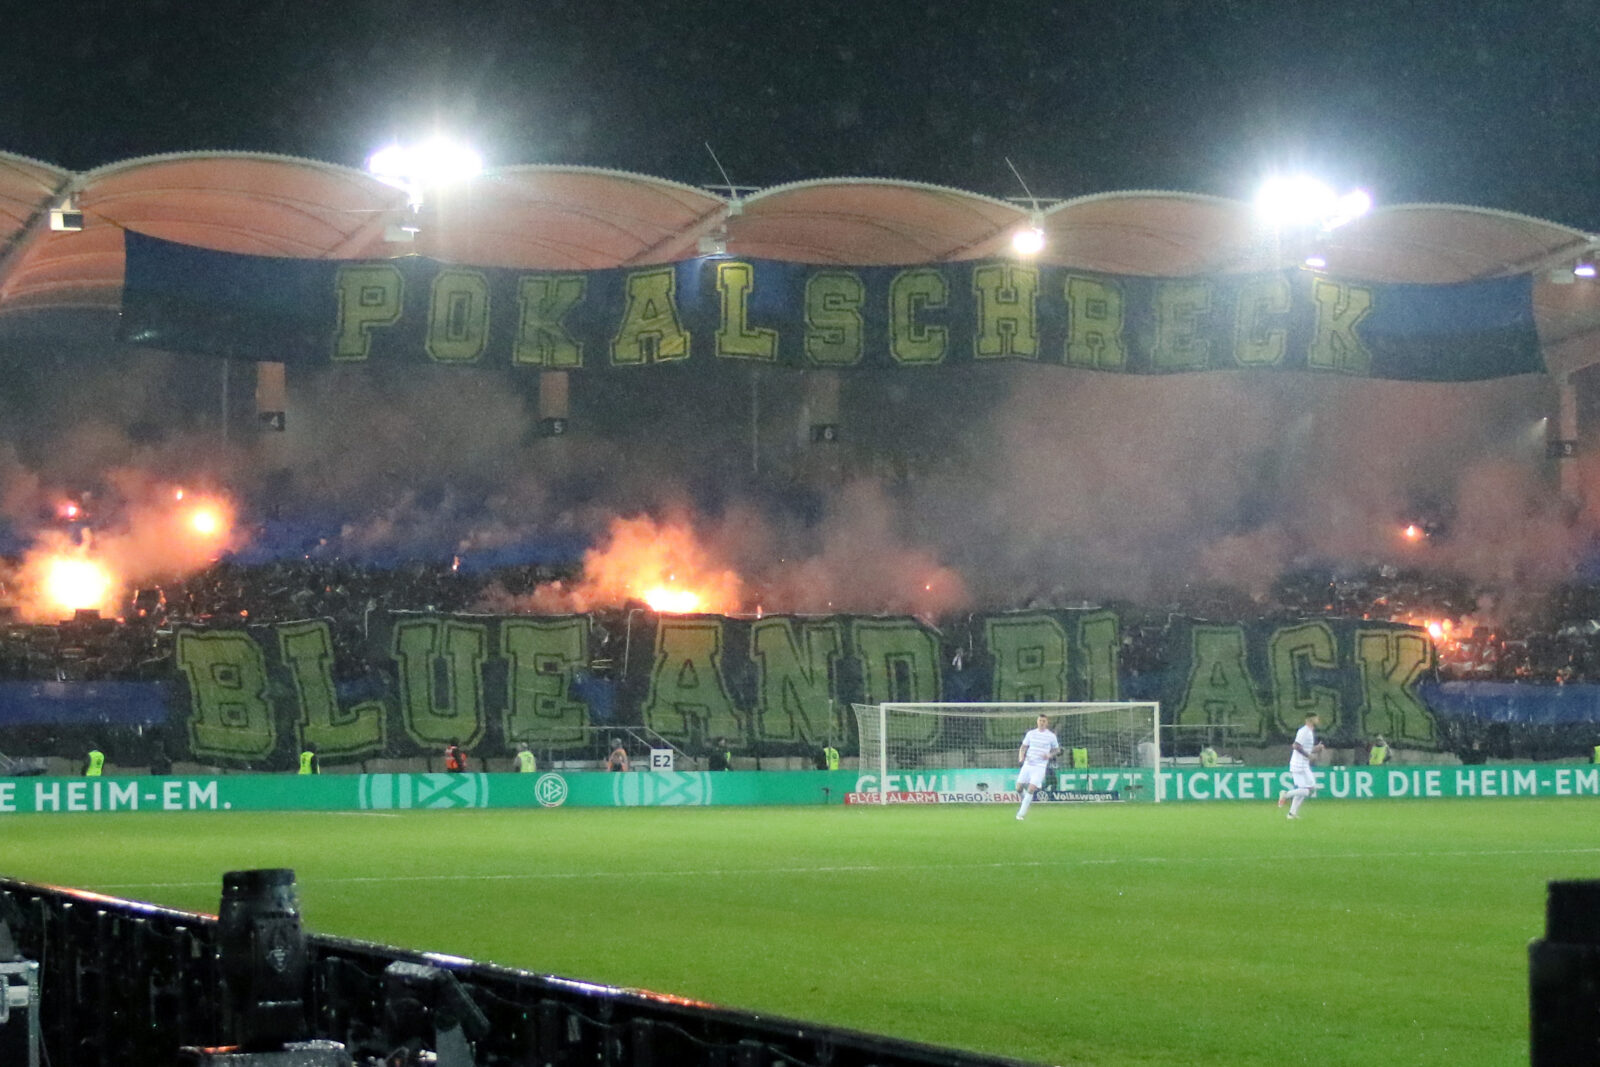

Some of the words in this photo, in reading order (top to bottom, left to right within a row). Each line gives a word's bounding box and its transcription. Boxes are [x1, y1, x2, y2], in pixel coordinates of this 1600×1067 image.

[331, 260, 1372, 376] POKALSCHRECK
[174, 616, 592, 762] BLUE
[641, 612, 945, 752] AND
[653, 755, 671, 767] E2
[35, 780, 233, 811] HEIM-EM.
[849, 792, 936, 803] FLYEALARM
[1053, 792, 1113, 801] Volkswagen
[1046, 773, 1142, 798] ETZT
[1154, 772, 1296, 799] TICKETS
[1312, 766, 1374, 797] FÜR
[1388, 771, 1441, 796] DIE
